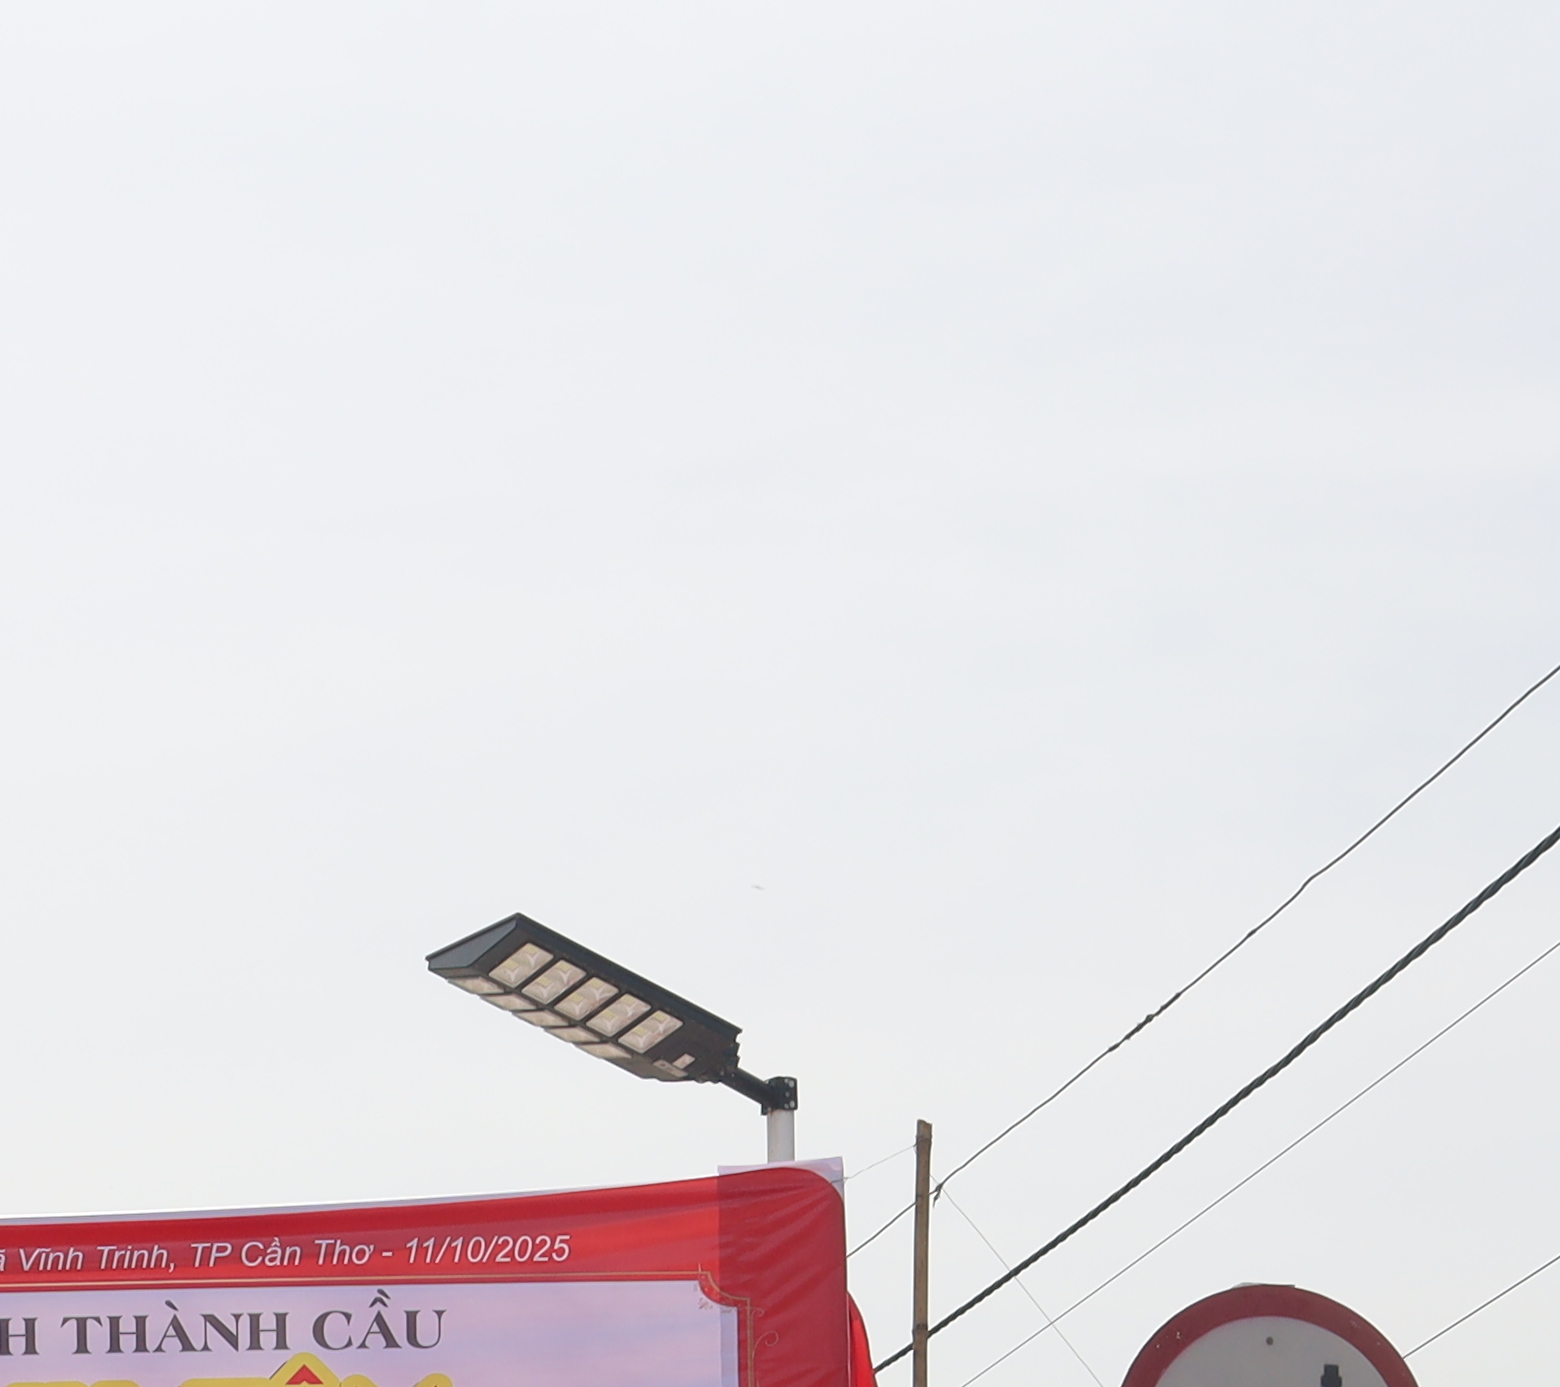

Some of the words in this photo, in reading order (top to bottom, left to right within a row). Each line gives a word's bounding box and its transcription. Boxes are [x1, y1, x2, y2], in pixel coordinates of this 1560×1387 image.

[19, 1247, 83, 1271] Vĩnh
[97, 1245, 176, 1273] Trinh,
[191, 1243, 232, 1267] TP
[241, 1237, 301, 1267] Cần
[314, 1239, 374, 1265] Thơ
[405, 1234, 571, 1264] 11/10/2025
[60, 1300, 289, 1355] THÀNH
[312, 1288, 447, 1350] CẦU
